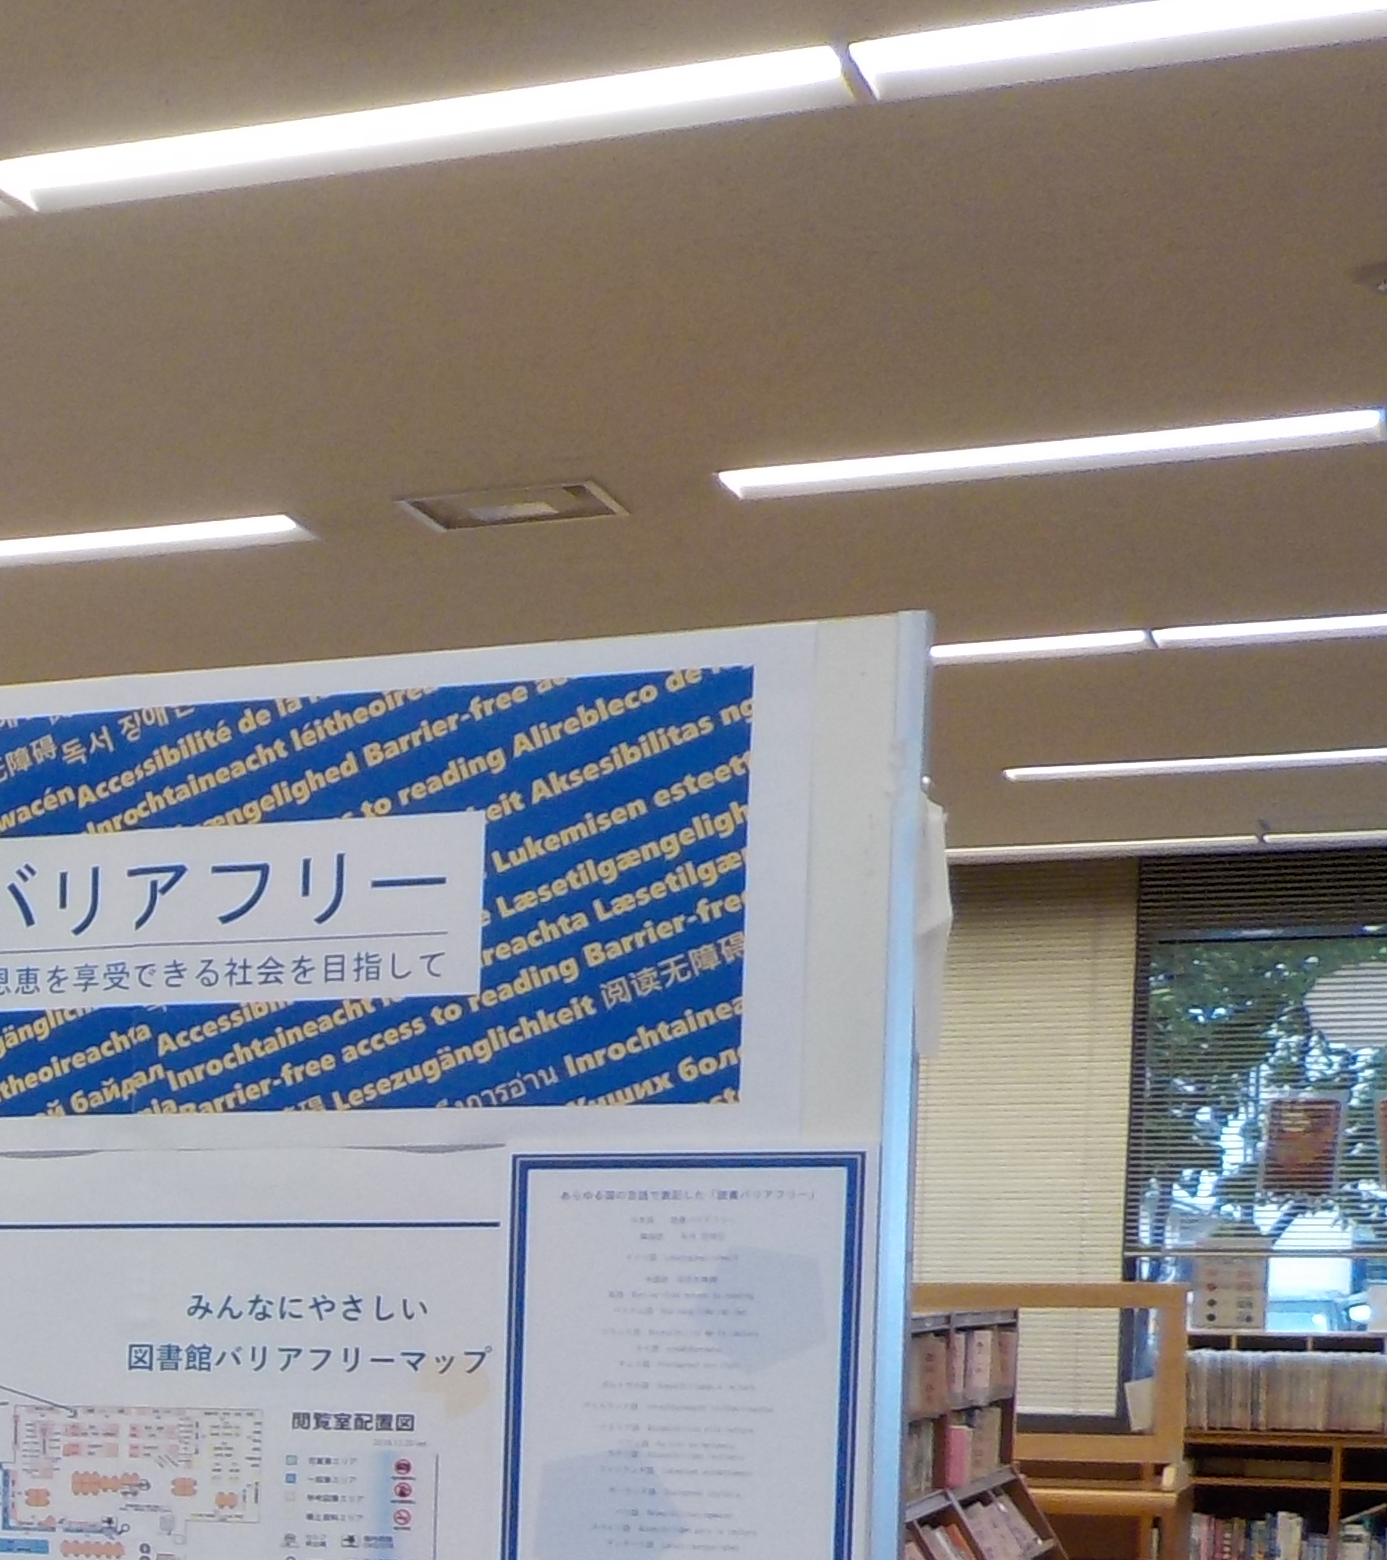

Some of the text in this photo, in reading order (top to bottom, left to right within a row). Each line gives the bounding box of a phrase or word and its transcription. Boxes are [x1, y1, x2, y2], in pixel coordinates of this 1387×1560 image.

[62, 725, 115, 766] 독서
[78, 720, 232, 809] Accessibilité
[238, 708, 272, 735] de
[363, 685, 529, 767] Barrier-free
[399, 667, 703, 807] reading Alirebleco de
[531, 716, 714, 804] Aksesibilitas
[492, 799, 648, 873] Lukemisen
[480, 911, 589, 967] reachta
[165, 998, 377, 1092] Inrochtaineacht
[342, 1016, 427, 1064] access
[432, 1003, 463, 1027] to
[469, 957, 579, 1013] reading
[333, 995, 598, 1113] Lesezugänglichkeit
[185, 1293, 429, 1322] みんなにやさしい
[127, 1343, 494, 1376] 図書館バリアフリーマップ
[291, 1412, 416, 1432] 閲覧室配置図
